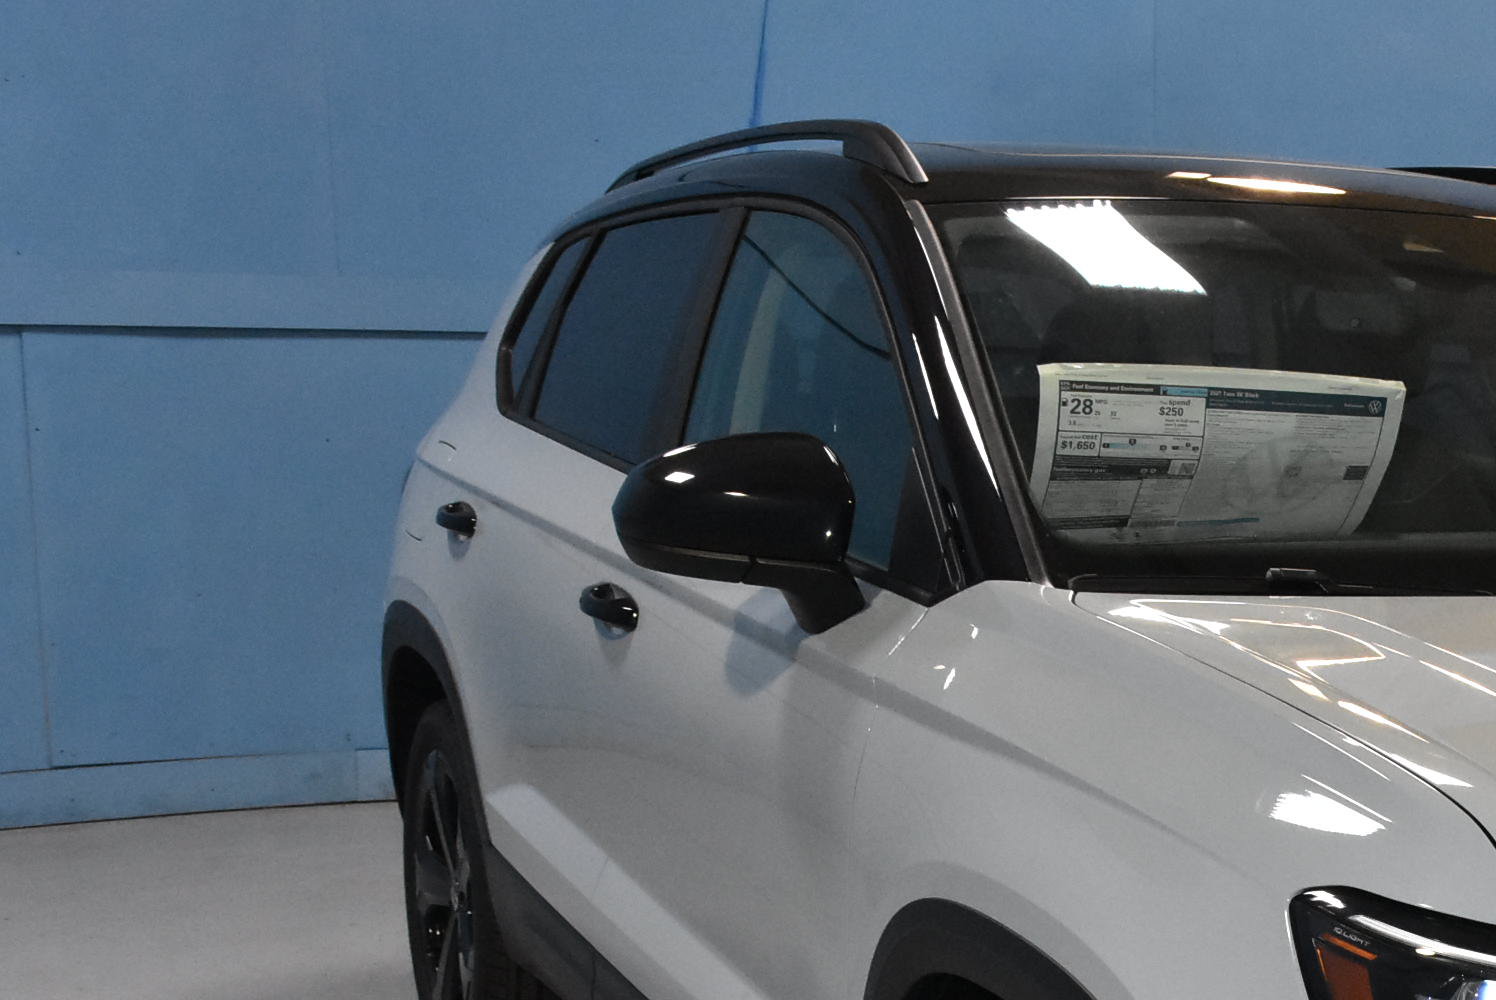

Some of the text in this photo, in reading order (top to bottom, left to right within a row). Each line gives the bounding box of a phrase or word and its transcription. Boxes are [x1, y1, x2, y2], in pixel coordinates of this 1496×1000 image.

[1070, 398, 1093, 415] 28
[1168, 399, 1191, 407] spend
[1158, 406, 1184, 417] $250
[1060, 439, 1096, 451] $1,650
